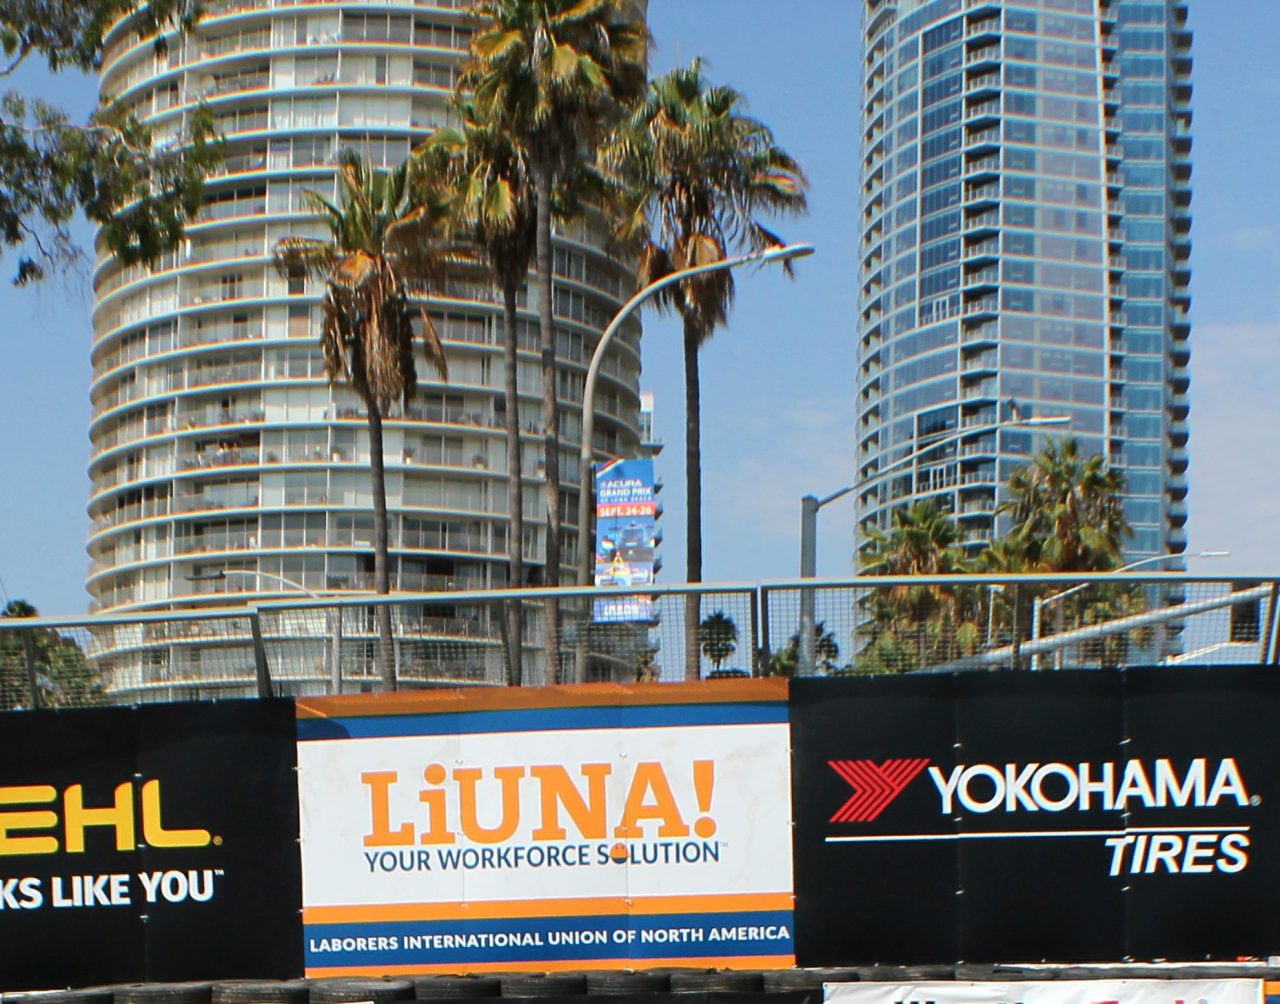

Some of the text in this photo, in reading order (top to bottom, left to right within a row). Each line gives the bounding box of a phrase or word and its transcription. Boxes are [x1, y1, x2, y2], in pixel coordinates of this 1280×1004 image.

[600, 486, 652, 497] GRAND PRIX
[607, 479, 642, 488] ACURA
[600, 504, 652, 517] SEPT. 24-26
[927, 758, 1250, 814] YOKOHAMA
[361, 759, 718, 847] LiUNA!
[363, 849, 432, 873] YOUR
[438, 846, 592, 872] WORKFORCE
[1105, 834, 1251, 876] TIRES
[51, 874, 132, 908] LIKE
[138, 869, 216, 903] YOU
[309, 926, 790, 952] LABORERS INTERNATIONAL UNION OF NORTH AMERICA
